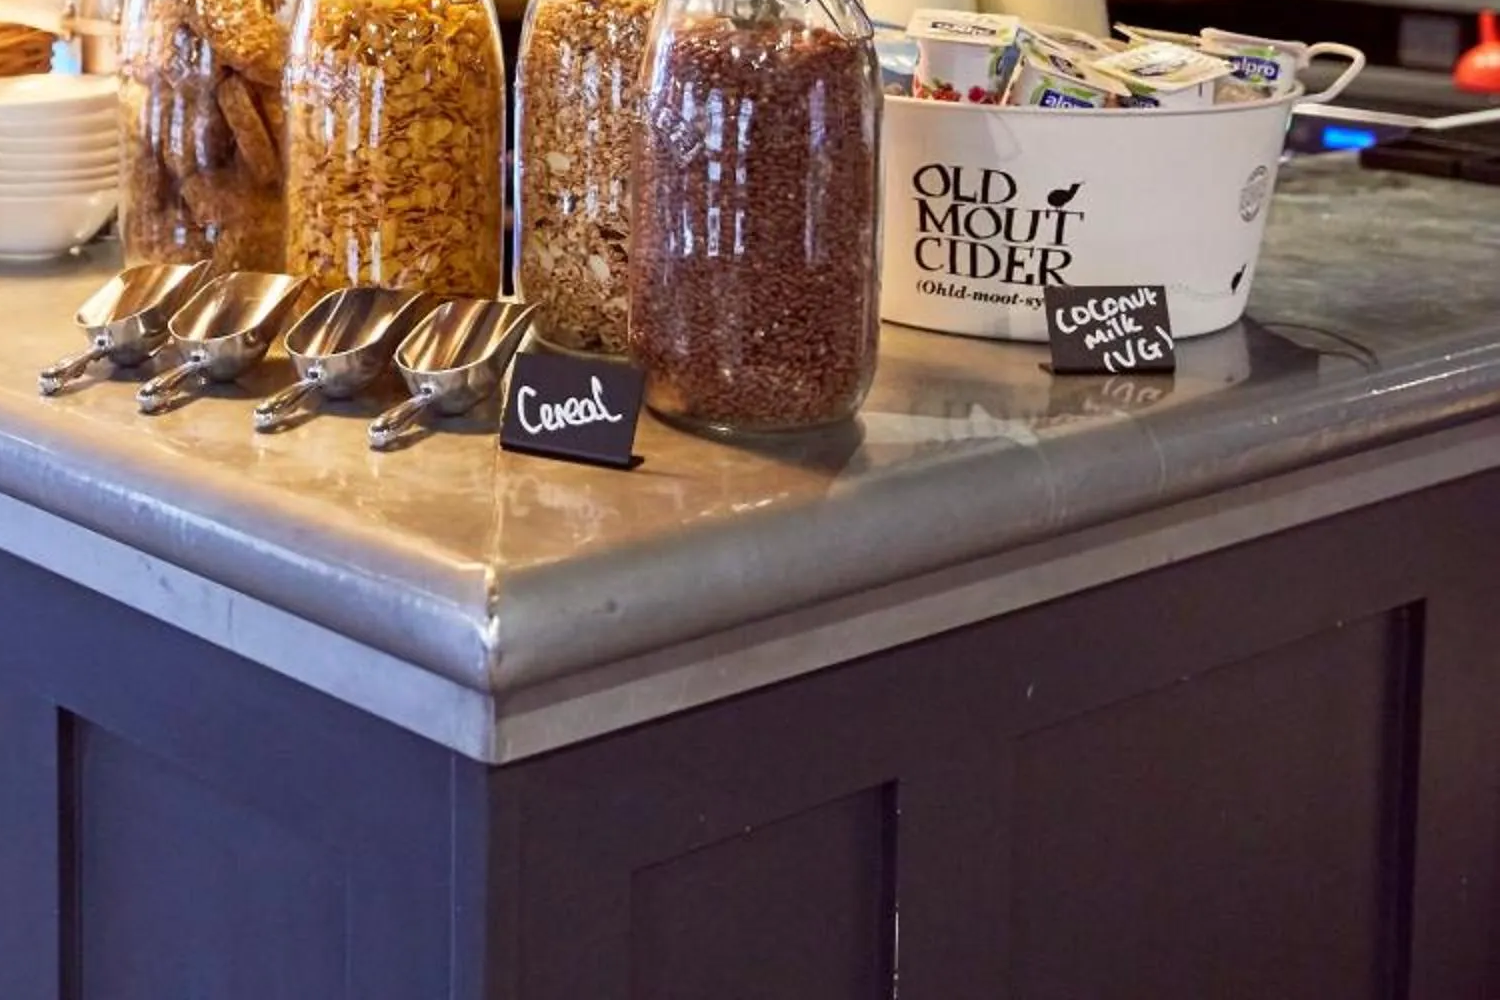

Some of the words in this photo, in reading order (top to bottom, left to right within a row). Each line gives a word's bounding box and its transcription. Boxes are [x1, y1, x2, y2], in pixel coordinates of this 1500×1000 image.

[912, 163, 1018, 205] OLD
[913, 197, 1085, 246] MOUT
[915, 236, 1073, 286] CIDER
[916, 279, 1043, 311] (Ohld-moot-sy
[1103, 325, 1175, 373] (VG)
[517, 375, 623, 435] Cereal
